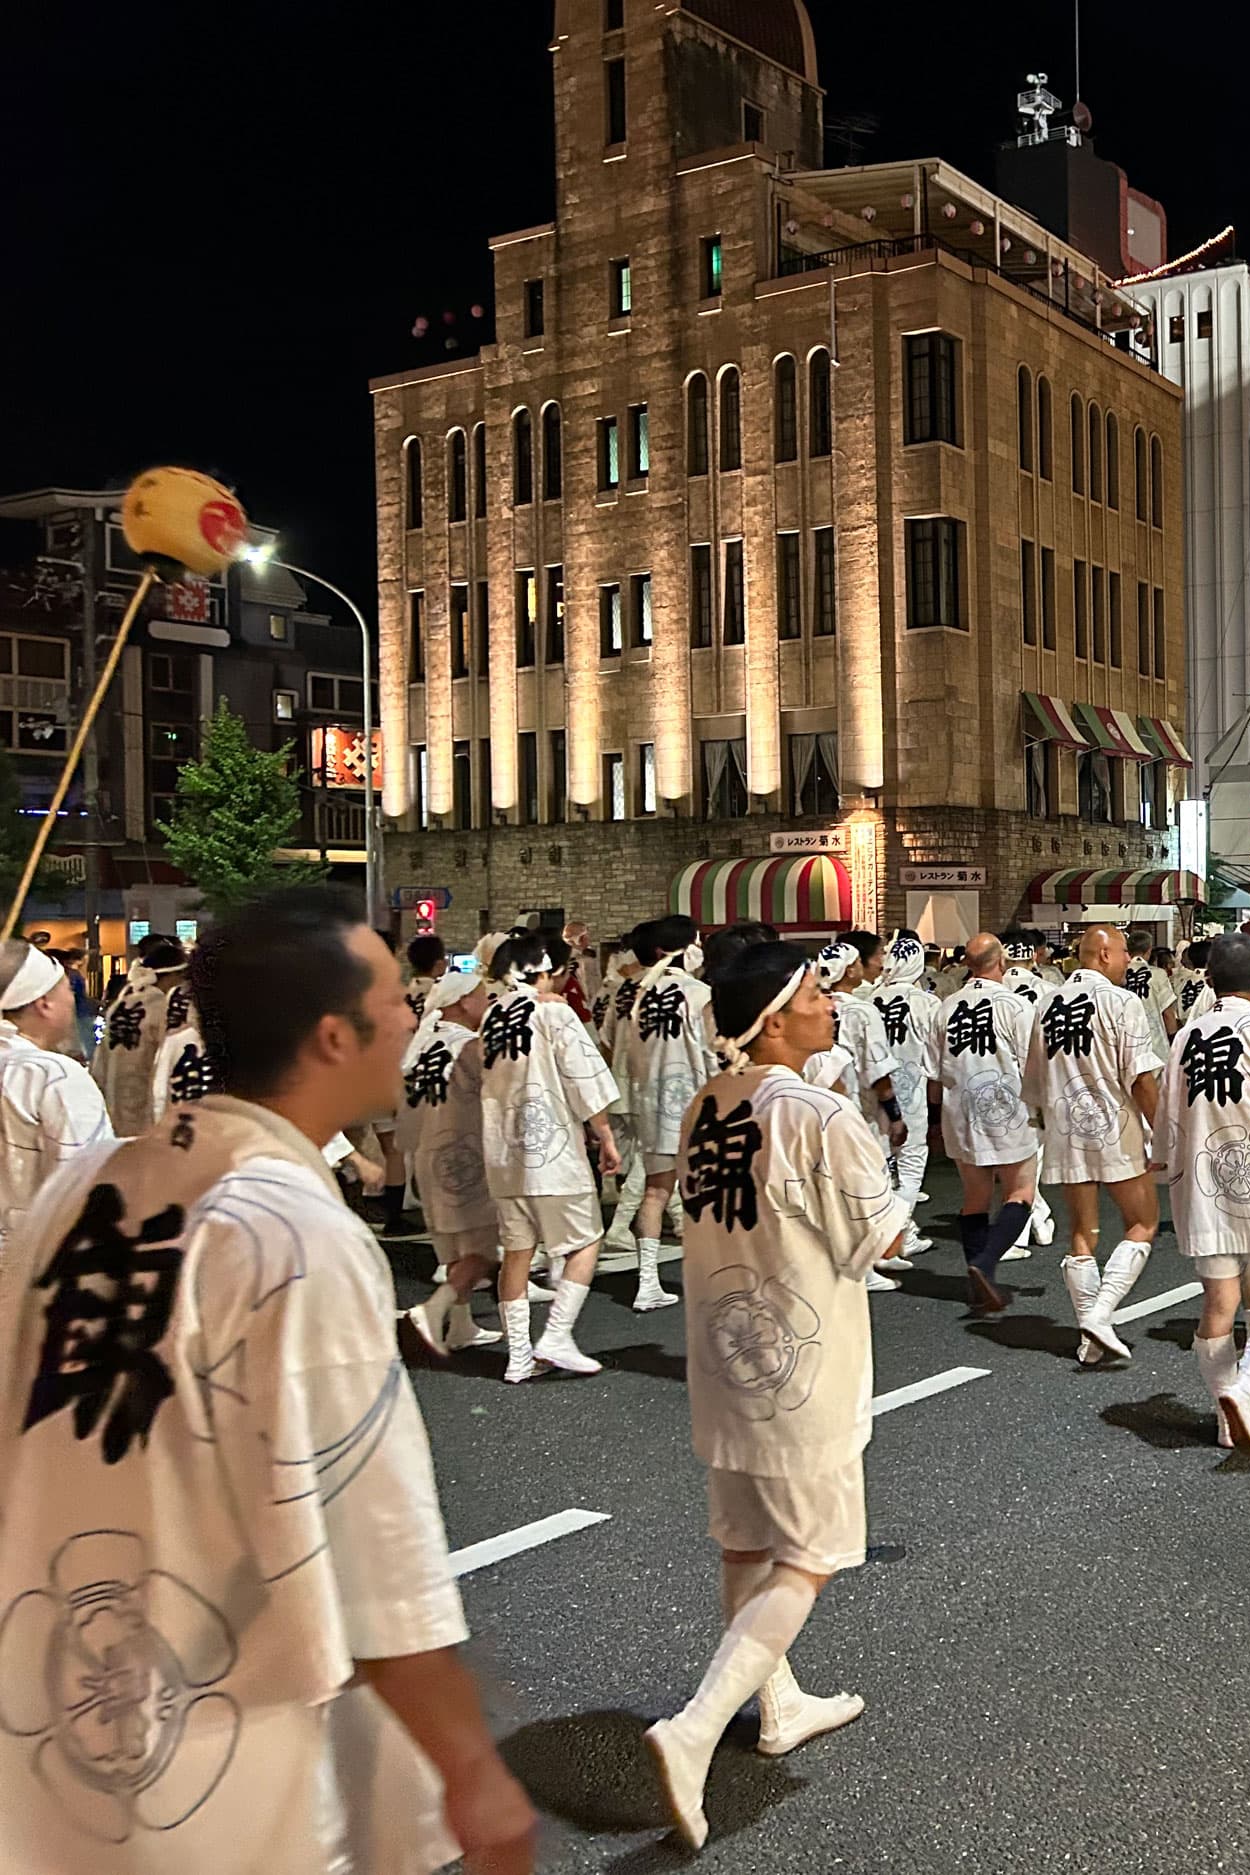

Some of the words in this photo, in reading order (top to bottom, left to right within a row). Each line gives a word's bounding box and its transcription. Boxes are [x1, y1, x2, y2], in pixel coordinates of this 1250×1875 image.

[787, 834, 841, 847] レストラン菊水
[919, 870, 982, 882] レストラン菊水
[110, 1001, 146, 1050] 錦
[484, 996, 536, 1069] 錦
[640, 983, 686, 1042] 錦
[947, 998, 997, 1057] 錦
[1040, 992, 1096, 1060] 錦
[404, 1040, 453, 1107] 錦
[1179, 1026, 1245, 1107] 錦
[682, 1094, 764, 1232] 錦
[22, 1182, 187, 1465] 錦
